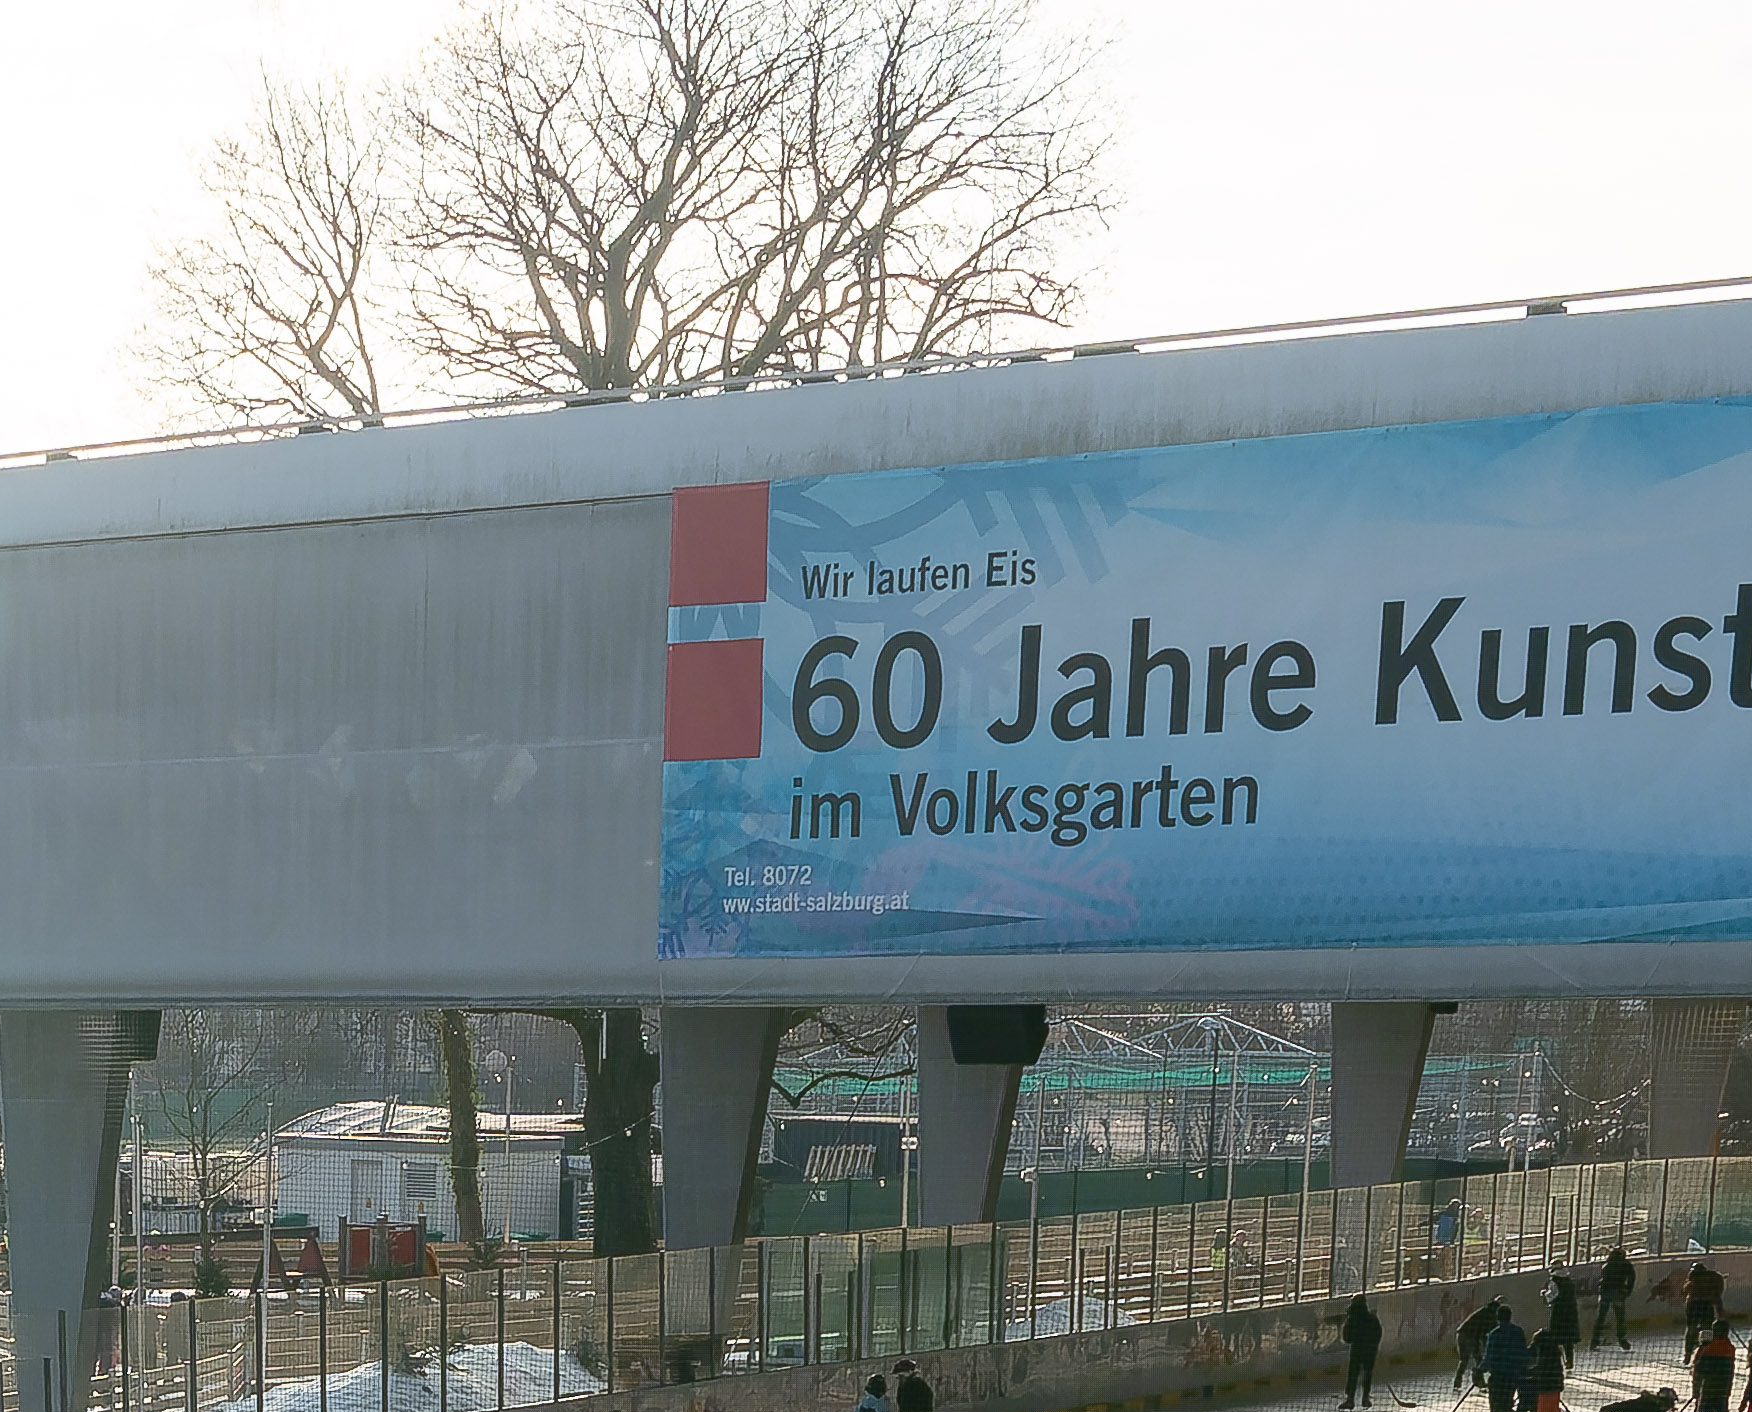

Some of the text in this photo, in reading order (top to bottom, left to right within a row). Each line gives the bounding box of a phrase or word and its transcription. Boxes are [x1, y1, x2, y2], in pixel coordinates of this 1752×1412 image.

[800, 547, 1037, 600] Wir laufen Eis
[791, 630, 944, 753] 60
[987, 616, 1317, 746] Jahre
[790, 765, 1259, 848] im Volksgarten
[724, 865, 812, 887] Tel. 8072
